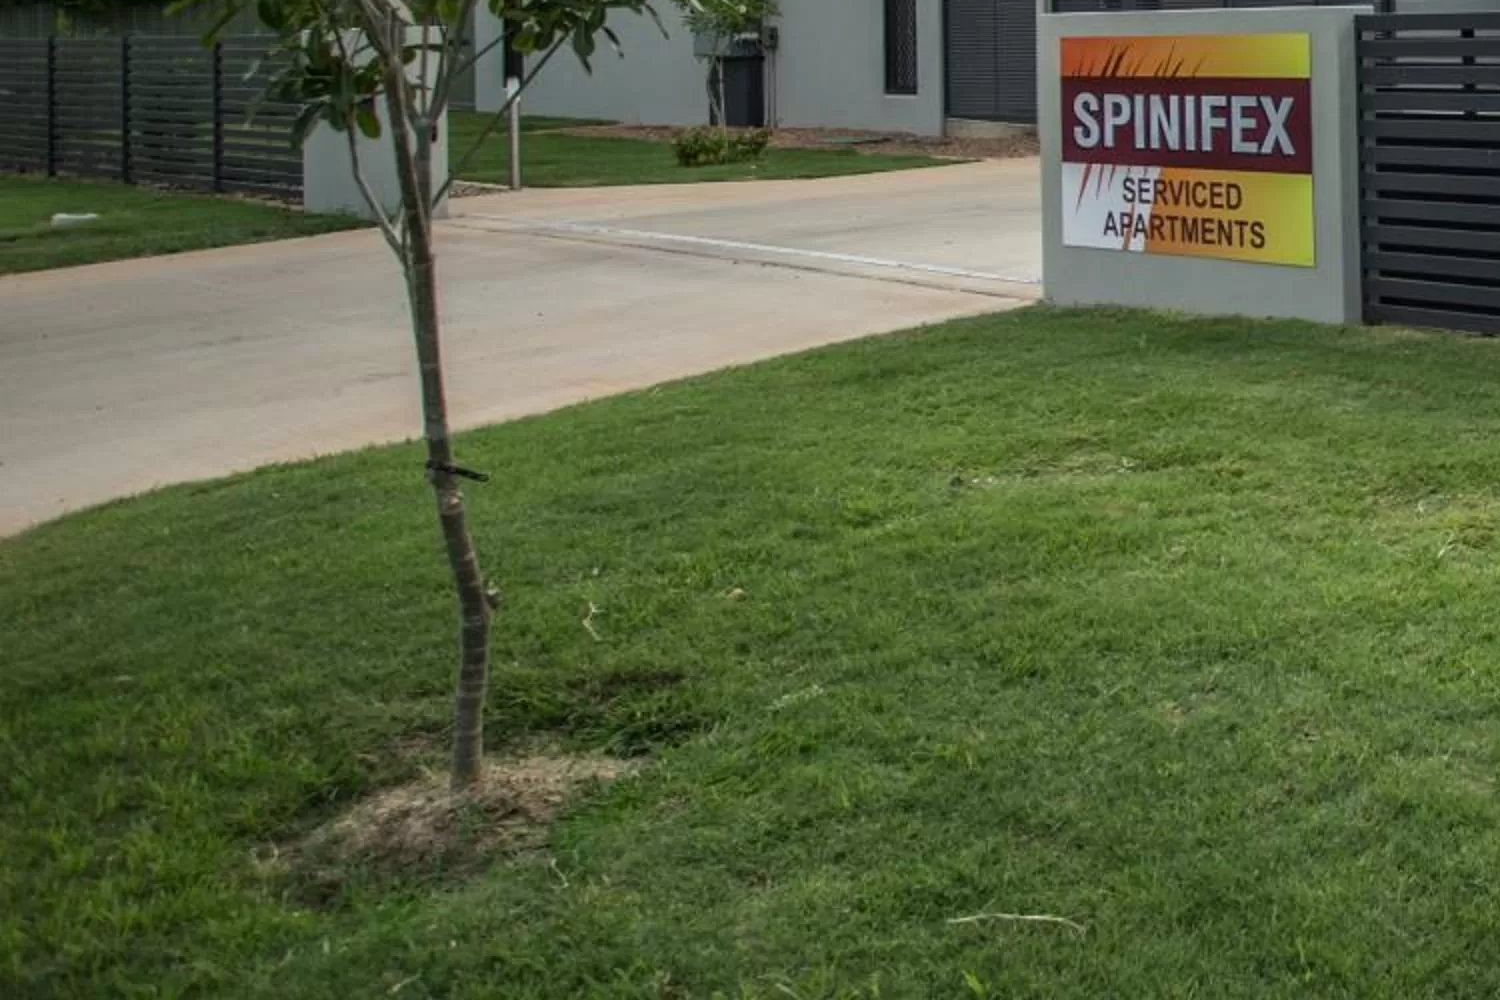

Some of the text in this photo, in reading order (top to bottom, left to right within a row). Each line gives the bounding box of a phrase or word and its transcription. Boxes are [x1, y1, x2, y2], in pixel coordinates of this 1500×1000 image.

[1073, 92, 1296, 155] SPINIFEX
[1122, 177, 1242, 210] SERVICED
[1103, 211, 1266, 249] APARTMENTS
